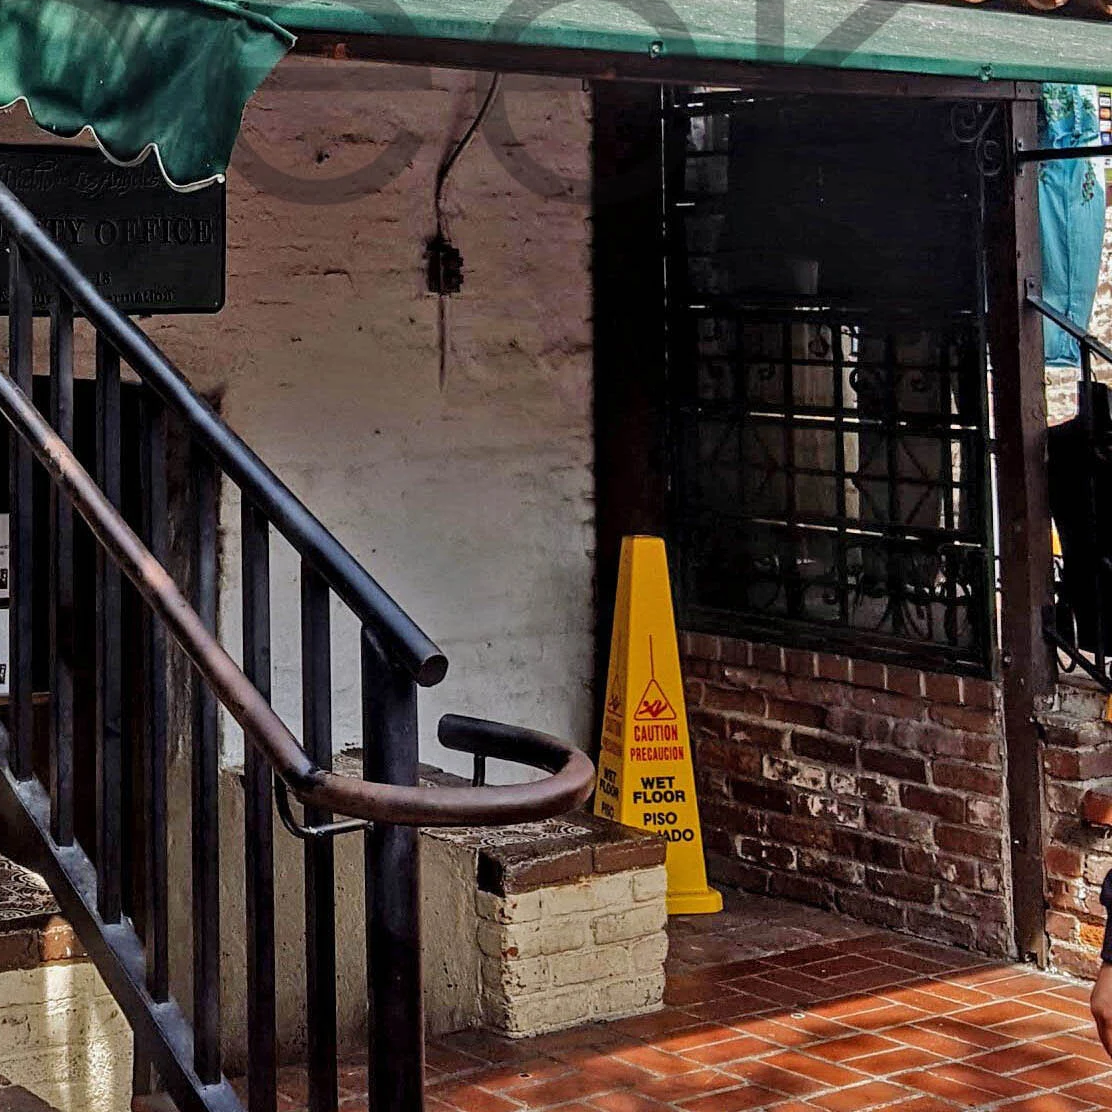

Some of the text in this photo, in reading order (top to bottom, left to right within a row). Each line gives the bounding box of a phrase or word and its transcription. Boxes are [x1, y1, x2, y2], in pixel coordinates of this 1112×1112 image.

[95, 219, 215, 247] OFFICE
[634, 724, 678, 742] CAUTION
[630, 746, 684, 761] PRECAUCION
[640, 776, 675, 789] WET
[633, 790, 686, 804] FLOOR
[644, 811, 678, 826] PISO
